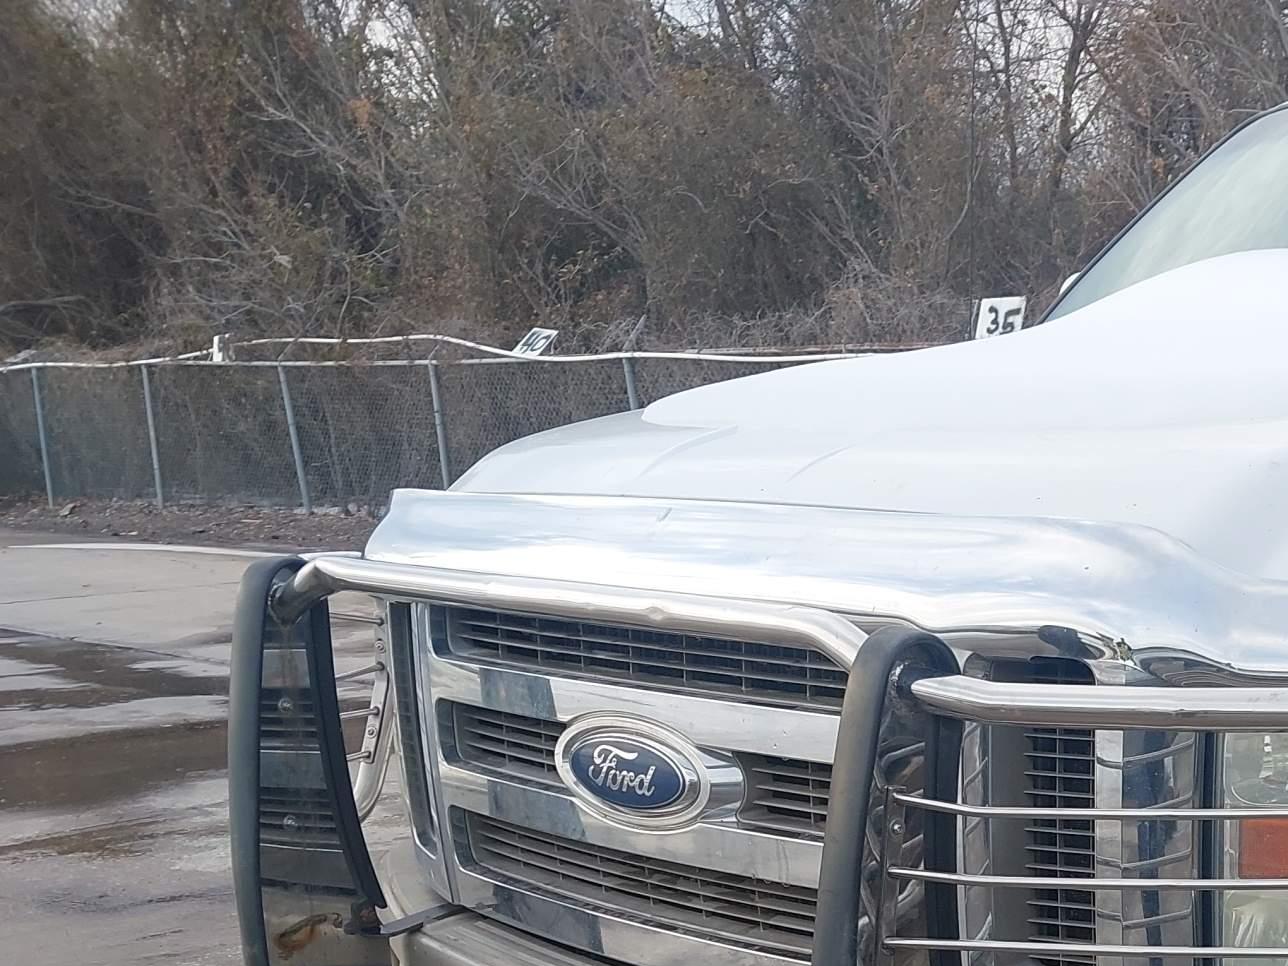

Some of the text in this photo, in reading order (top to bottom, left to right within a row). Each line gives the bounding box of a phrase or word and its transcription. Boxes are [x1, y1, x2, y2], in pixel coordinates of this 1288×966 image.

[986, 305, 1022, 335] 35
[519, 330, 552, 353] 40
[588, 744, 656, 797] Ford
